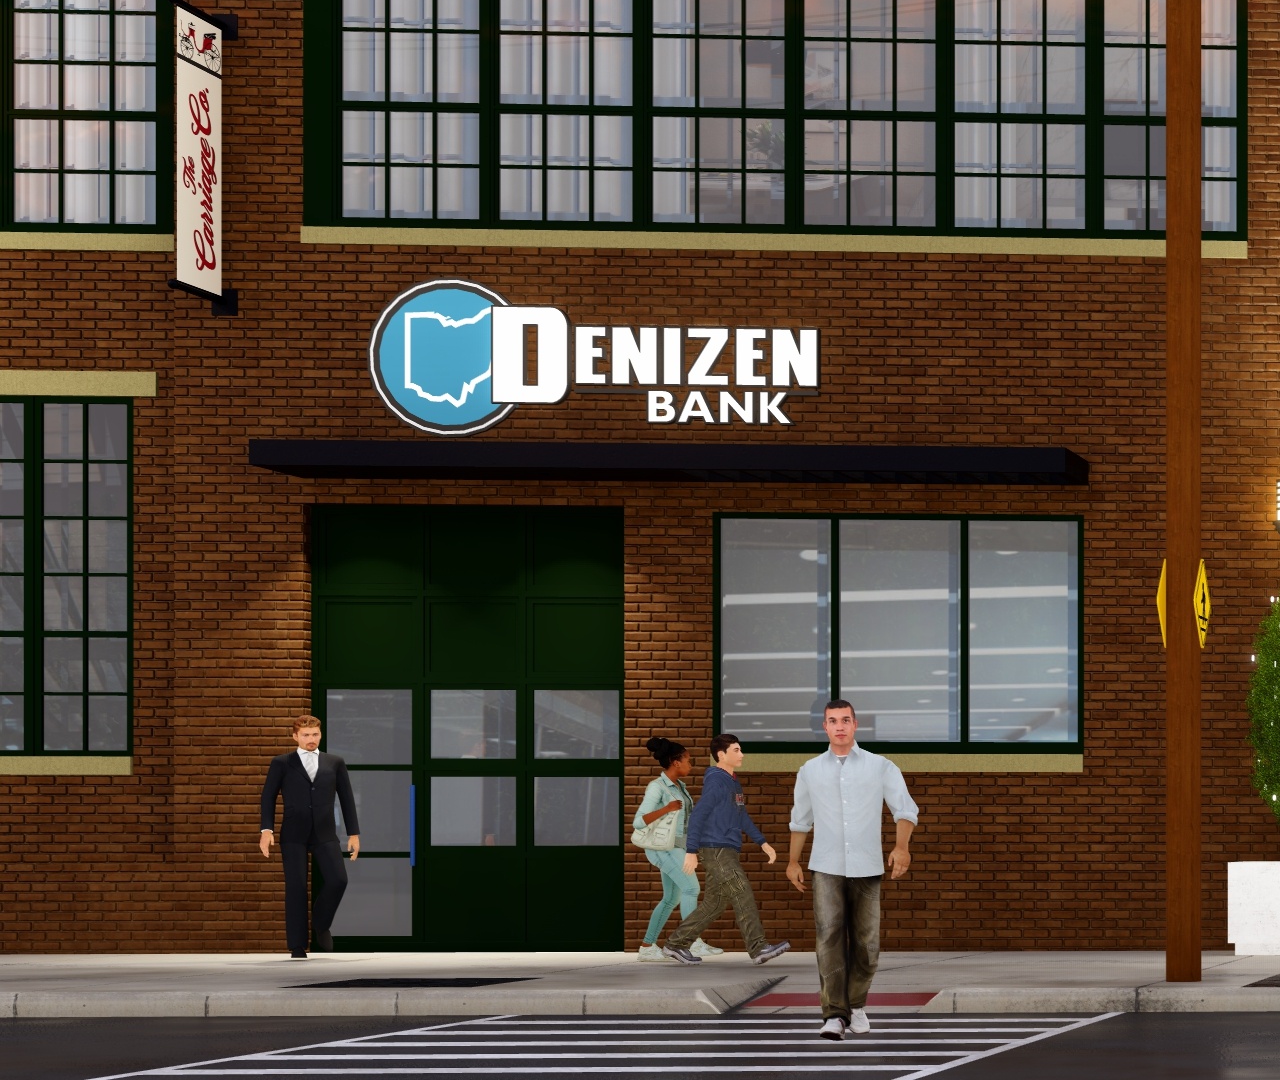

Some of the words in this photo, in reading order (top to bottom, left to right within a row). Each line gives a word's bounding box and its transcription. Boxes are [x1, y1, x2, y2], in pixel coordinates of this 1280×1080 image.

[188, 87, 212, 137] Co.
[182, 154, 197, 195] The
[193, 137, 218, 271] Carriage
[491, 305, 818, 404] DENIZEN
[647, 389, 792, 425] BANK
